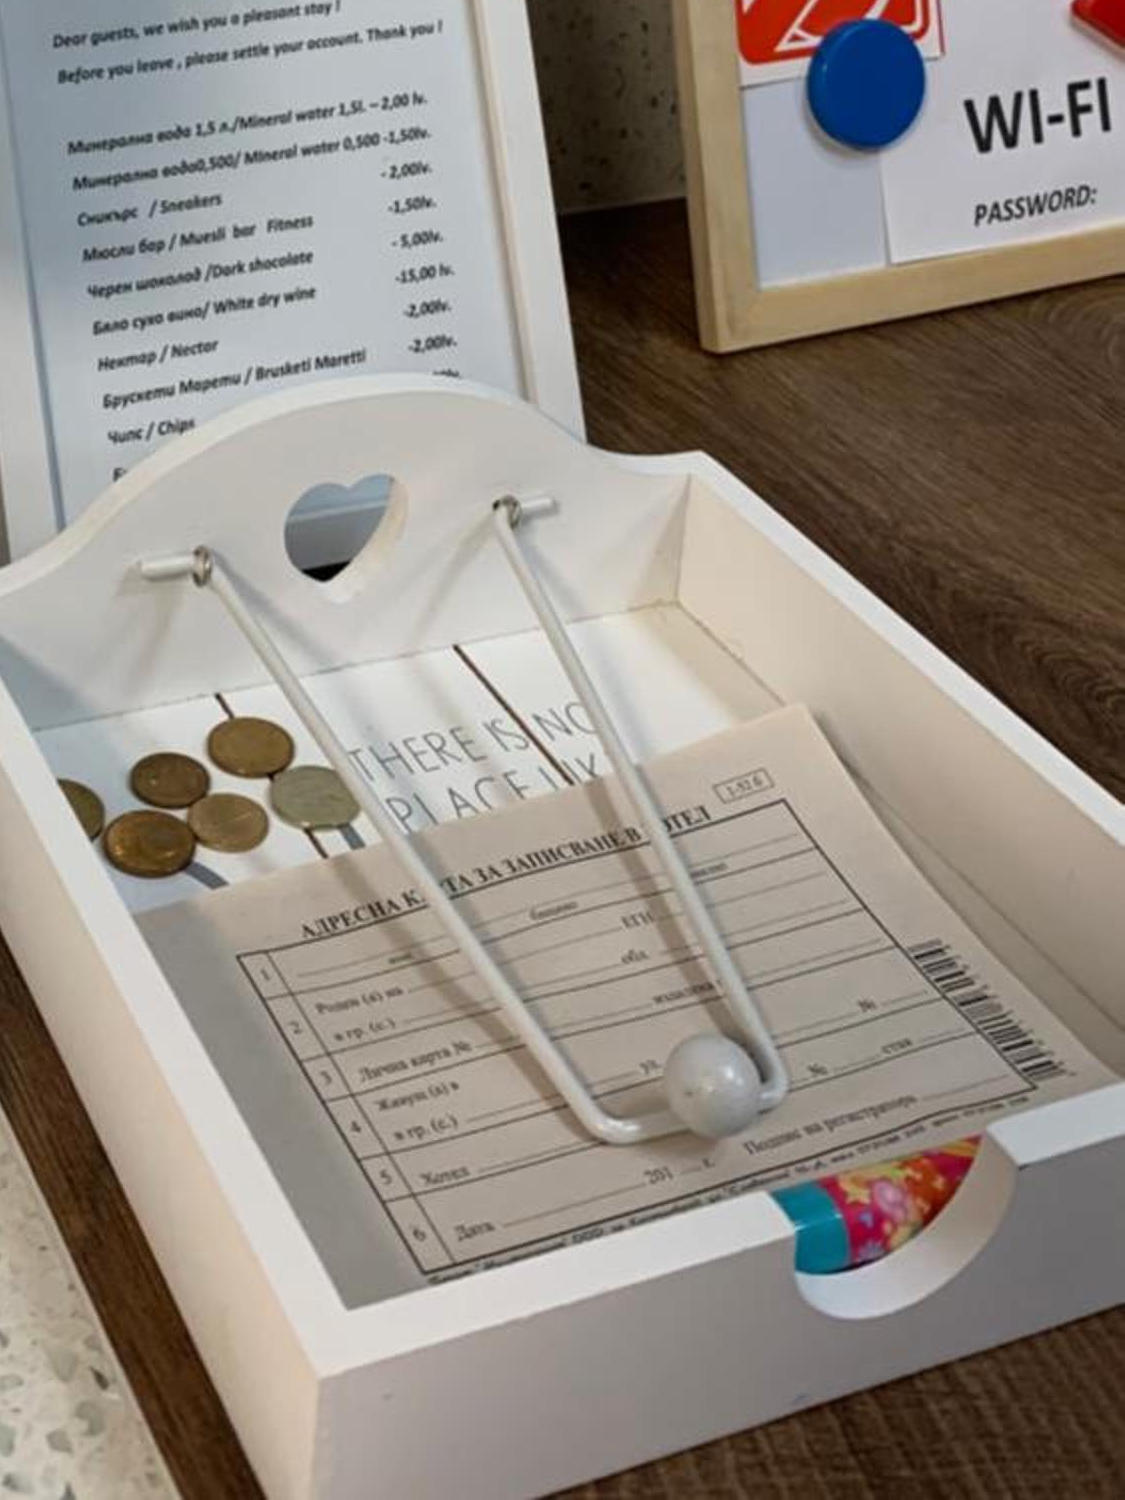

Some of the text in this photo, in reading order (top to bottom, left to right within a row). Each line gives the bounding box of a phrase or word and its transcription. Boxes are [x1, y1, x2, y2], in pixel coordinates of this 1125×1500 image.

[53, 1, 332, 48] Dear guests, we wish you a pleasant stay
[58, 22, 435, 84] Before you leave please settle your account. Thank you
[68, 132, 154, 155] Минерална
[157, 123, 192, 142] вода
[195, 120, 216, 137] 1,5
[295, 105, 335, 122] water
[381, 93, 409, 111] 2,00
[963, 77, 1112, 154] WI-FI
[72, 168, 158, 191] Минерална
[244, 143, 297, 165] Mineral
[301, 139, 340, 157] water
[342, 132, 380, 151] 0,500
[77, 206, 138, 227] Сникърс
[160, 194, 222, 214] Sneakers
[974, 184, 1097, 227] PASSWORD:
[82, 243, 135, 263] Мюсли
[138, 237, 165, 255] бар
[179, 227, 226, 247] Muesli
[232, 223, 257, 240] bar
[266, 215, 314, 233] Fitness
[87, 280, 132, 300] Черен
[135, 266, 202, 292] шоколад
[248, 250, 314, 274] shocolate
[92, 318, 129, 336] Бяло
[132, 313, 164, 331] сухо
[213, 296, 254, 315] White
[257, 291, 280, 308] dry
[283, 286, 316, 302] wine
[97, 349, 157, 372] Нектар
[170, 340, 219, 359] Nectar
[103, 385, 175, 409] Брускети
[255, 358, 311, 381] Brusketi
[108, 417, 196, 444] Чипс Chips
[348, 726, 489, 782] THERE
[483, 717, 530, 753] IS
[301, 826, 642, 938] АДРЕСНА КТА ЗА ЗАПИСВАНЕ В
[288, 1020, 303, 1035] 2
[359, 1057, 408, 1083] Лична
[410, 1047, 452, 1071] карта
[349, 1120, 362, 1134] 4
[379, 1165, 471, 1186] 5 Хотел
[412, 1225, 426, 1241] 6
[454, 1220, 496, 1243] Дата
